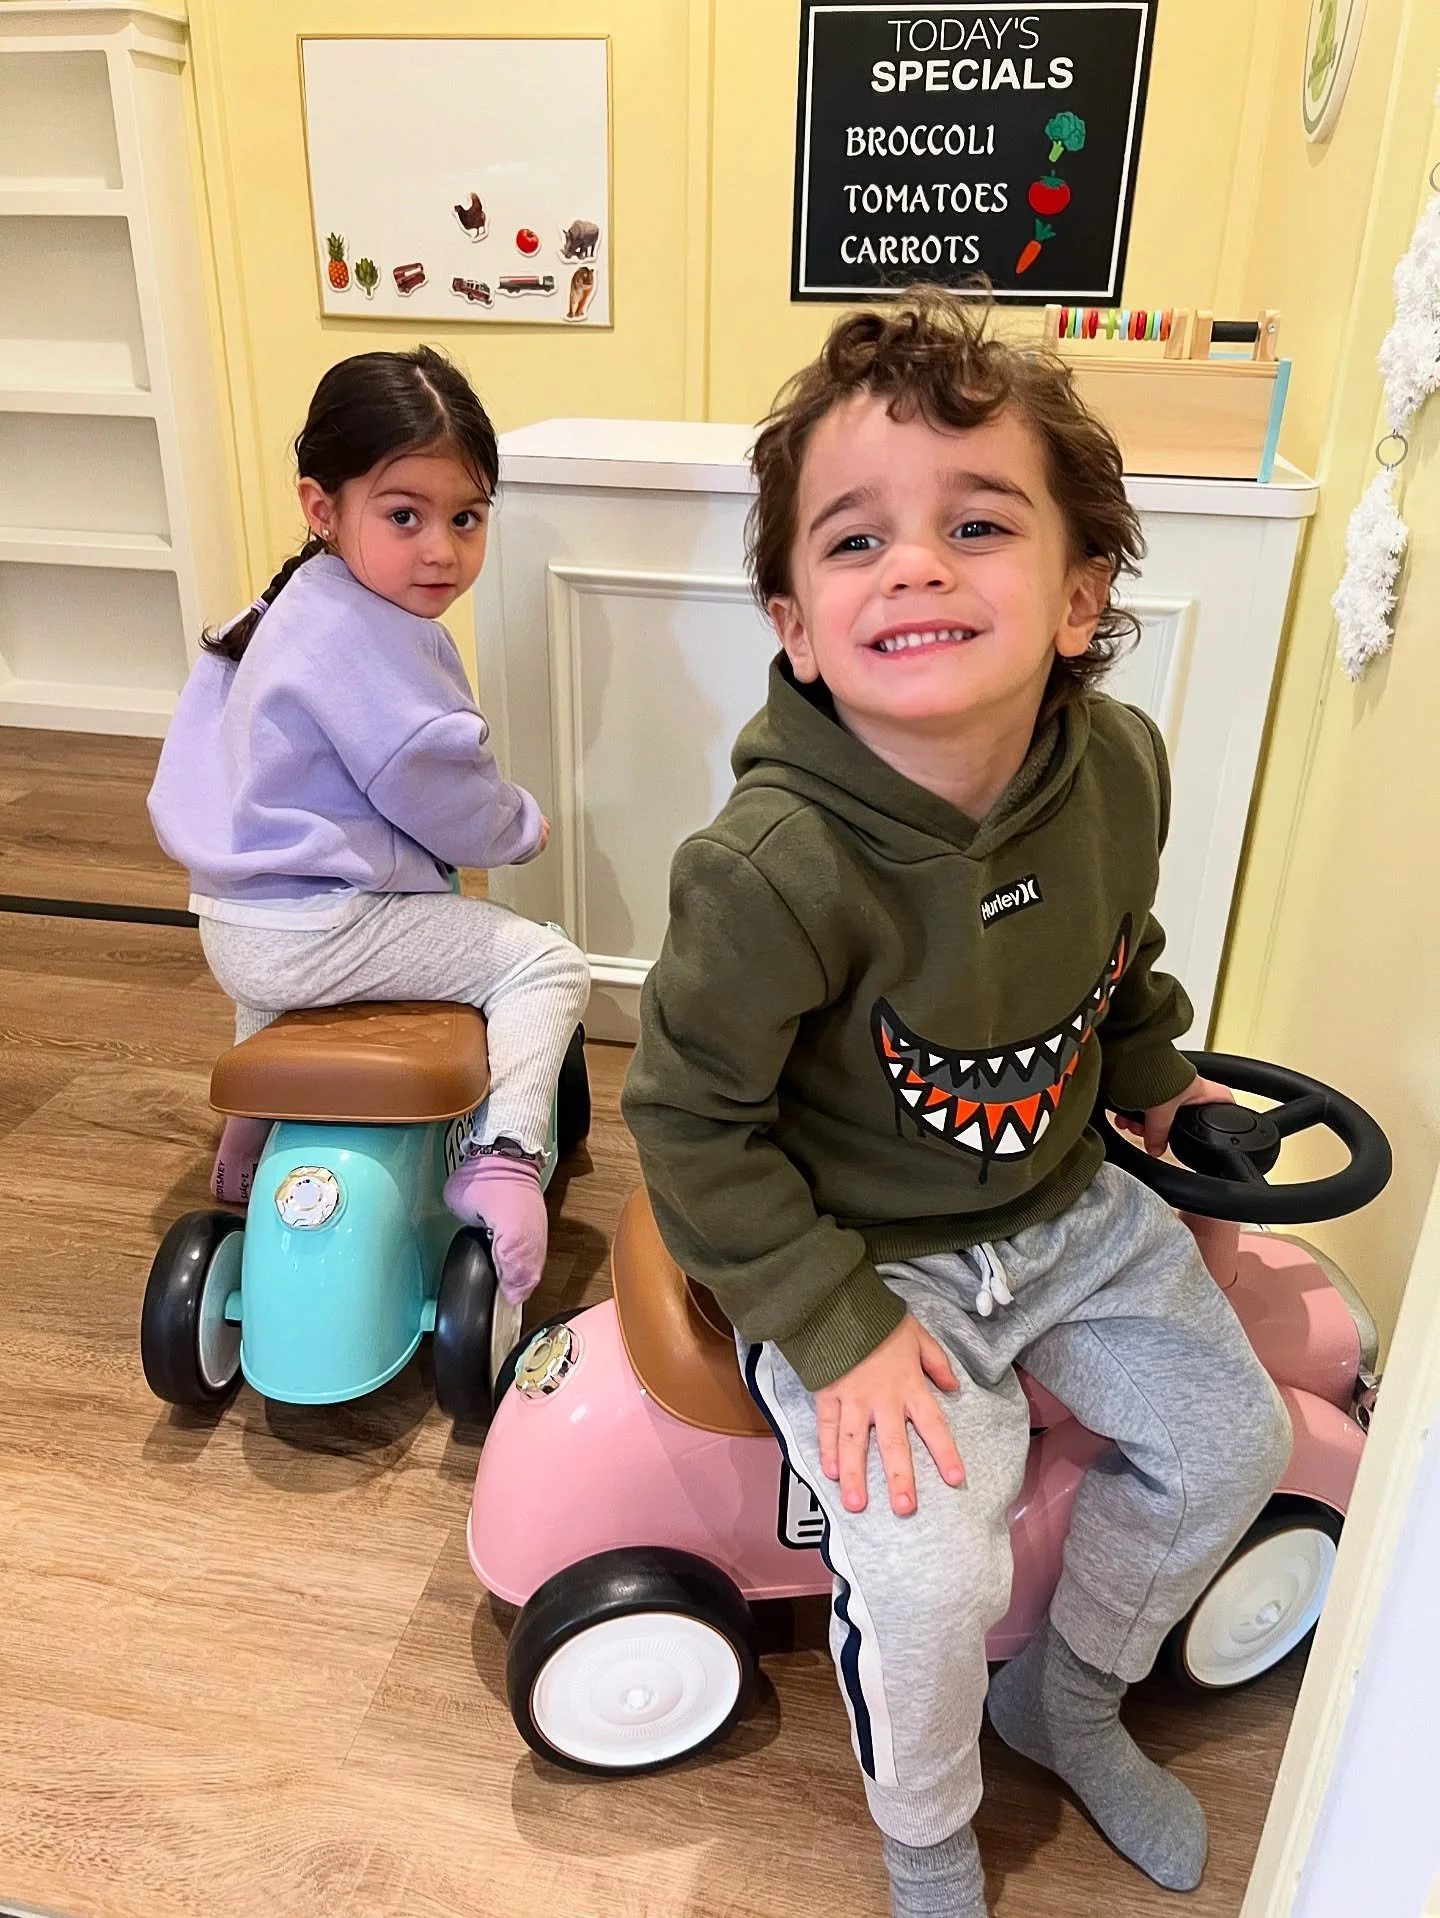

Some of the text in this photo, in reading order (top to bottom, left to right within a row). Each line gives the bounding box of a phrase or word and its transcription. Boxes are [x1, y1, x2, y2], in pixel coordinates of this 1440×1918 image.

[887, 16, 1040, 53] TODAY'S
[870, 56, 1074, 93] SPECIALS
[845, 123, 995, 157] BROCCOLI
[842, 182, 1008, 214] TOMATOES
[840, 234, 980, 265] CARROTS
[980, 889, 1020, 921] Hurley
